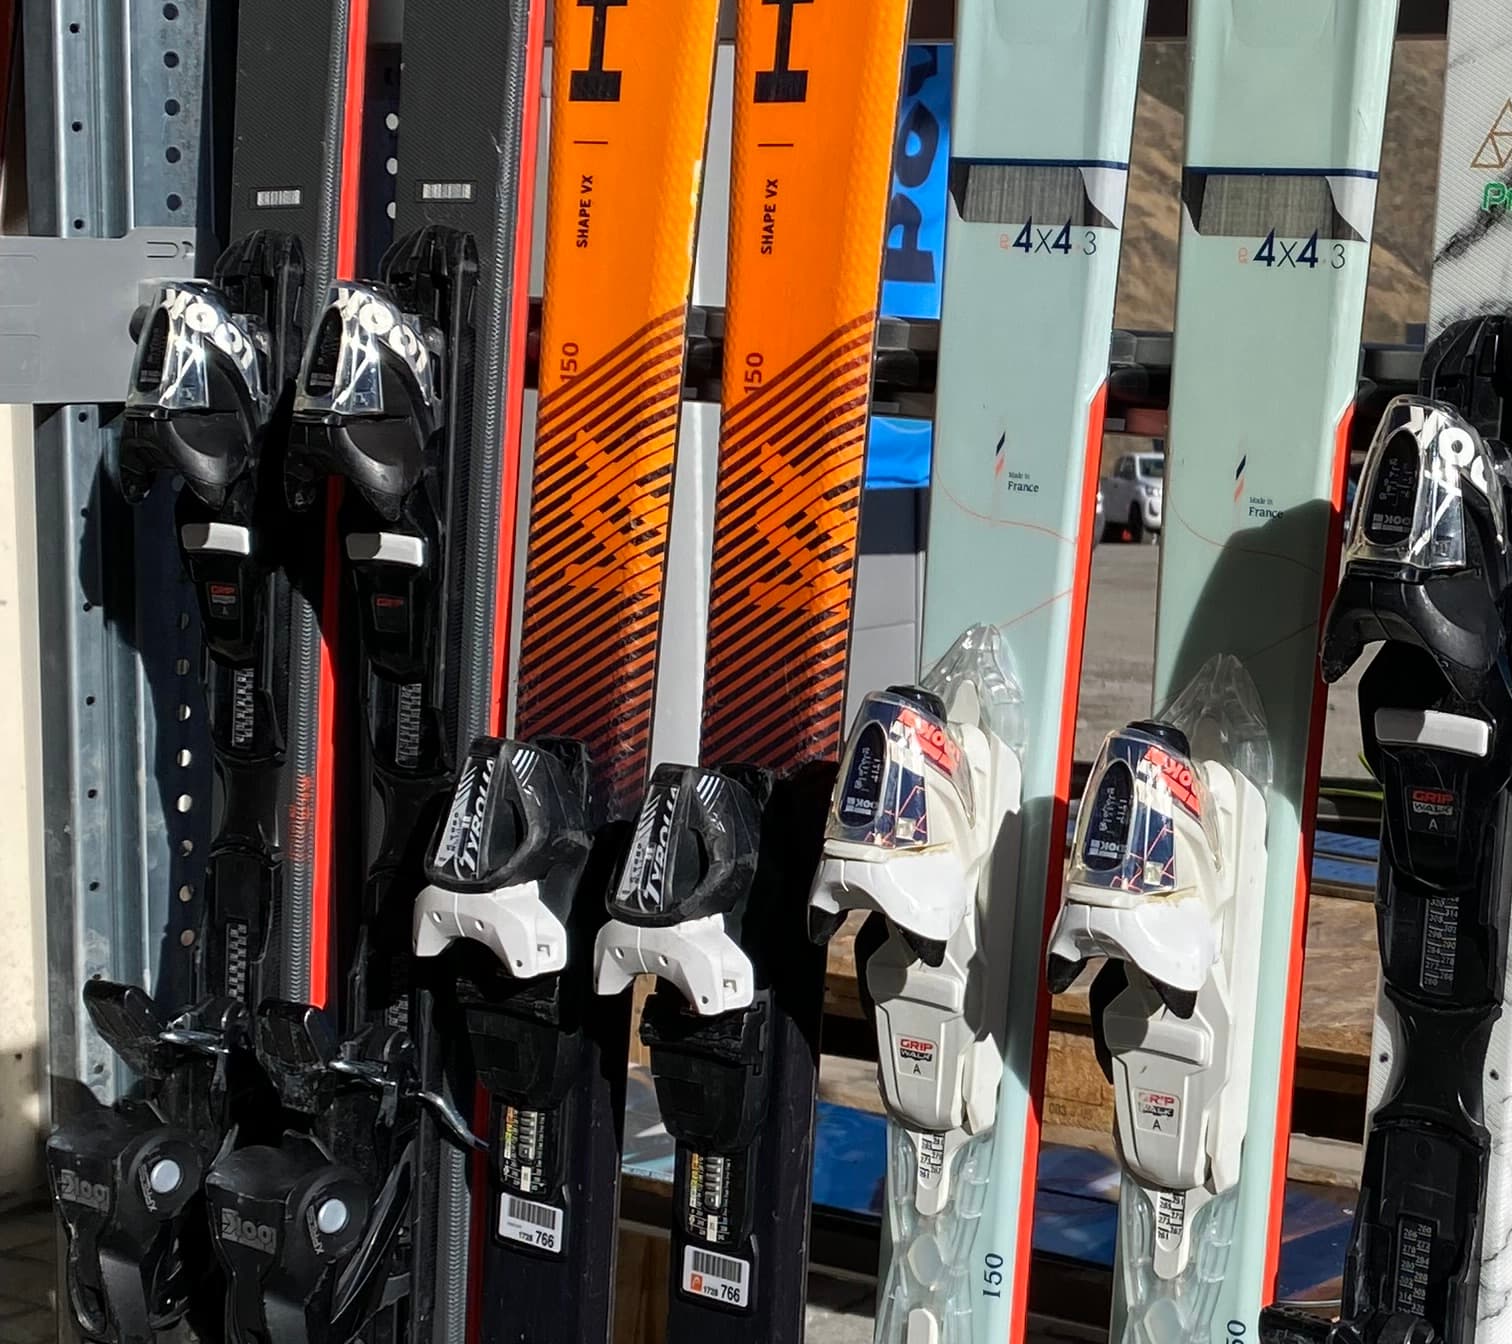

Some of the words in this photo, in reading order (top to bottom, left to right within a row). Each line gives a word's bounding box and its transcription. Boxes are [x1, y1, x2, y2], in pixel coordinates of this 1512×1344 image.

[581, 174, 594, 194] VX
[766, 178, 778, 199] VX
[576, 199, 591, 248] SHAPE
[761, 204, 777, 255] SHAPE
[744, 352, 764, 395] 150
[1008, 481, 1040, 493] France
[1248, 507, 1284, 520] France
[1411, 791, 1454, 803] GRIP
[900, 1038, 934, 1052] GRIP
[912, 1064, 921, 1075] A
[1152, 1118, 1161, 1130] A
[535, 1230, 555, 1249] 766
[982, 1252, 1004, 1299] 150
[721, 1283, 740, 1303] 766
